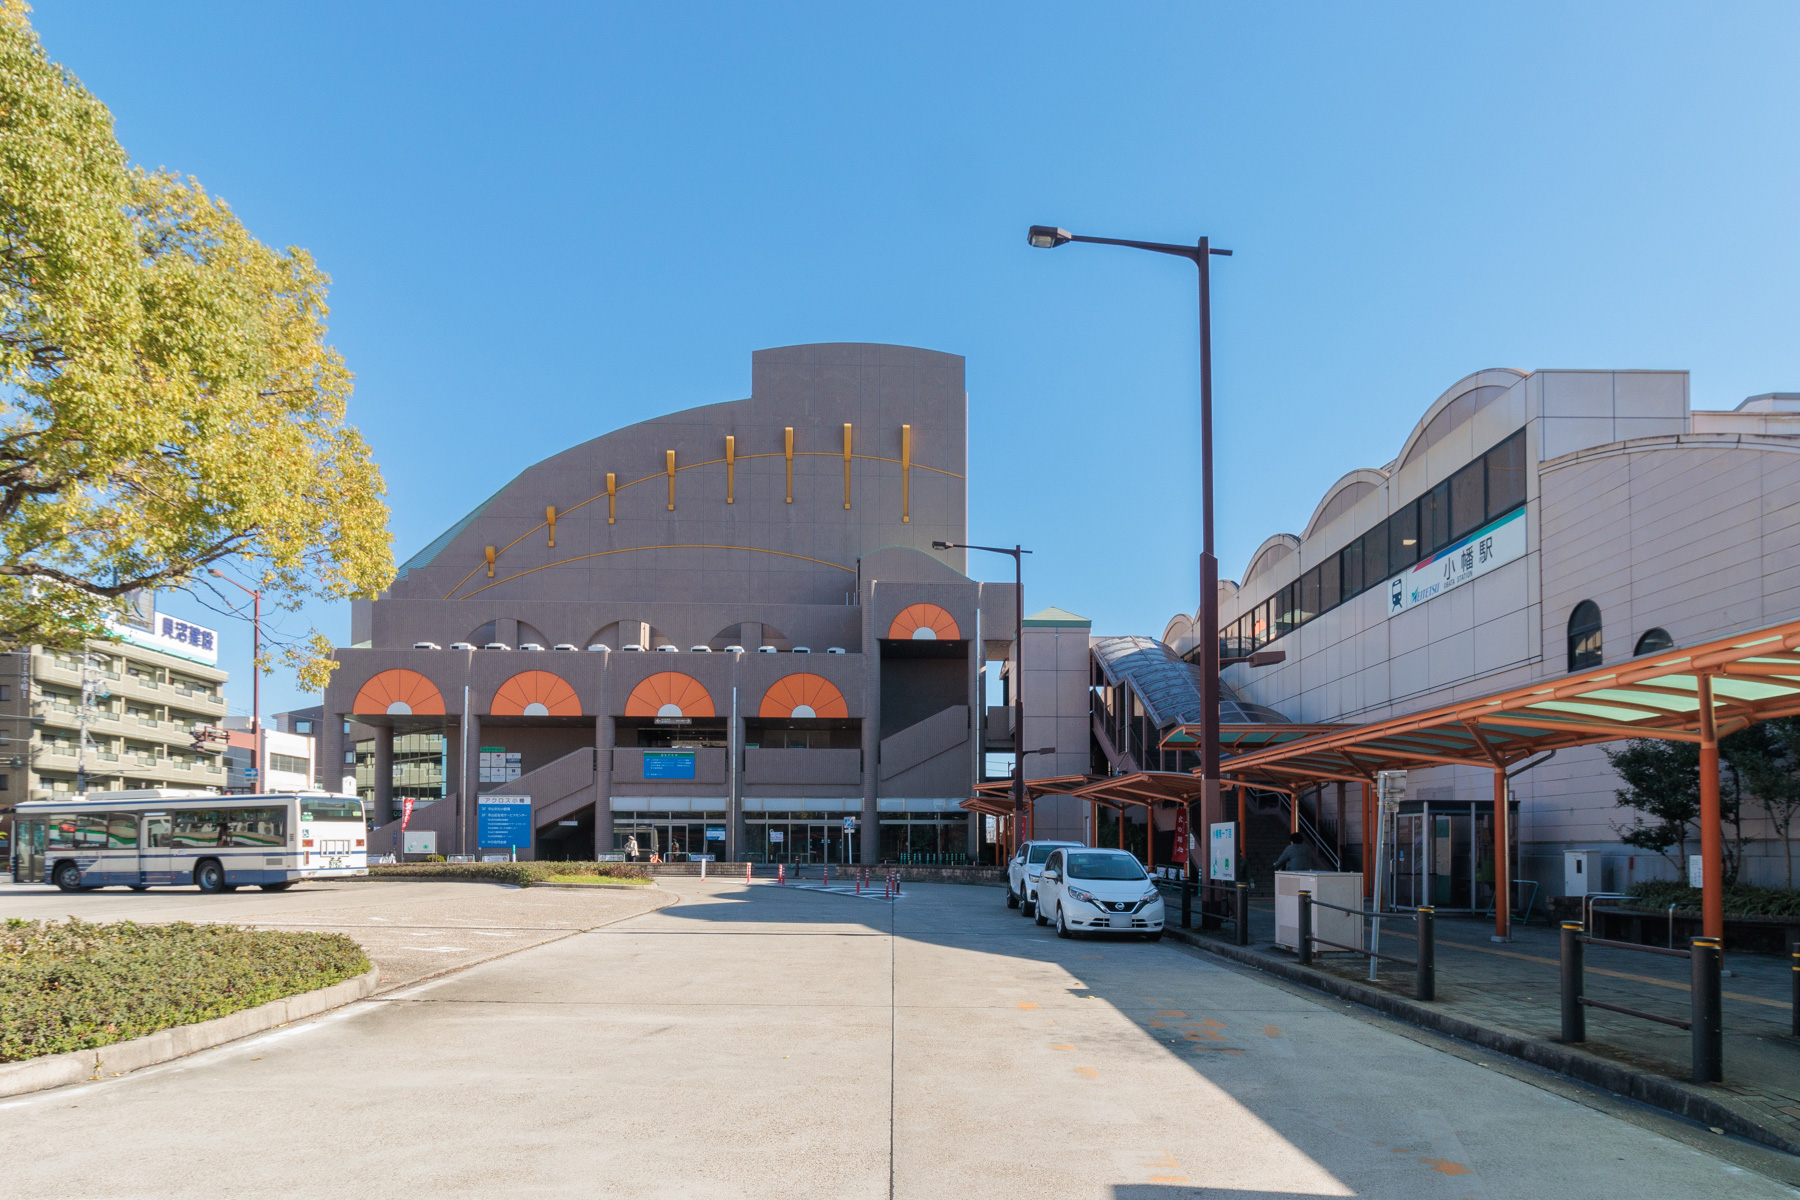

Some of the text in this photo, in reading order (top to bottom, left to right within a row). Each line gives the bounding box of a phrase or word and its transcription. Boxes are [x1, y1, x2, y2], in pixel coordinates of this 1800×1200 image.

[1443, 536, 1493, 581] 小幡駅
[1444, 570, 1473, 590] OBATA STATION
[161, 617, 214, 651] 貝沼建設
